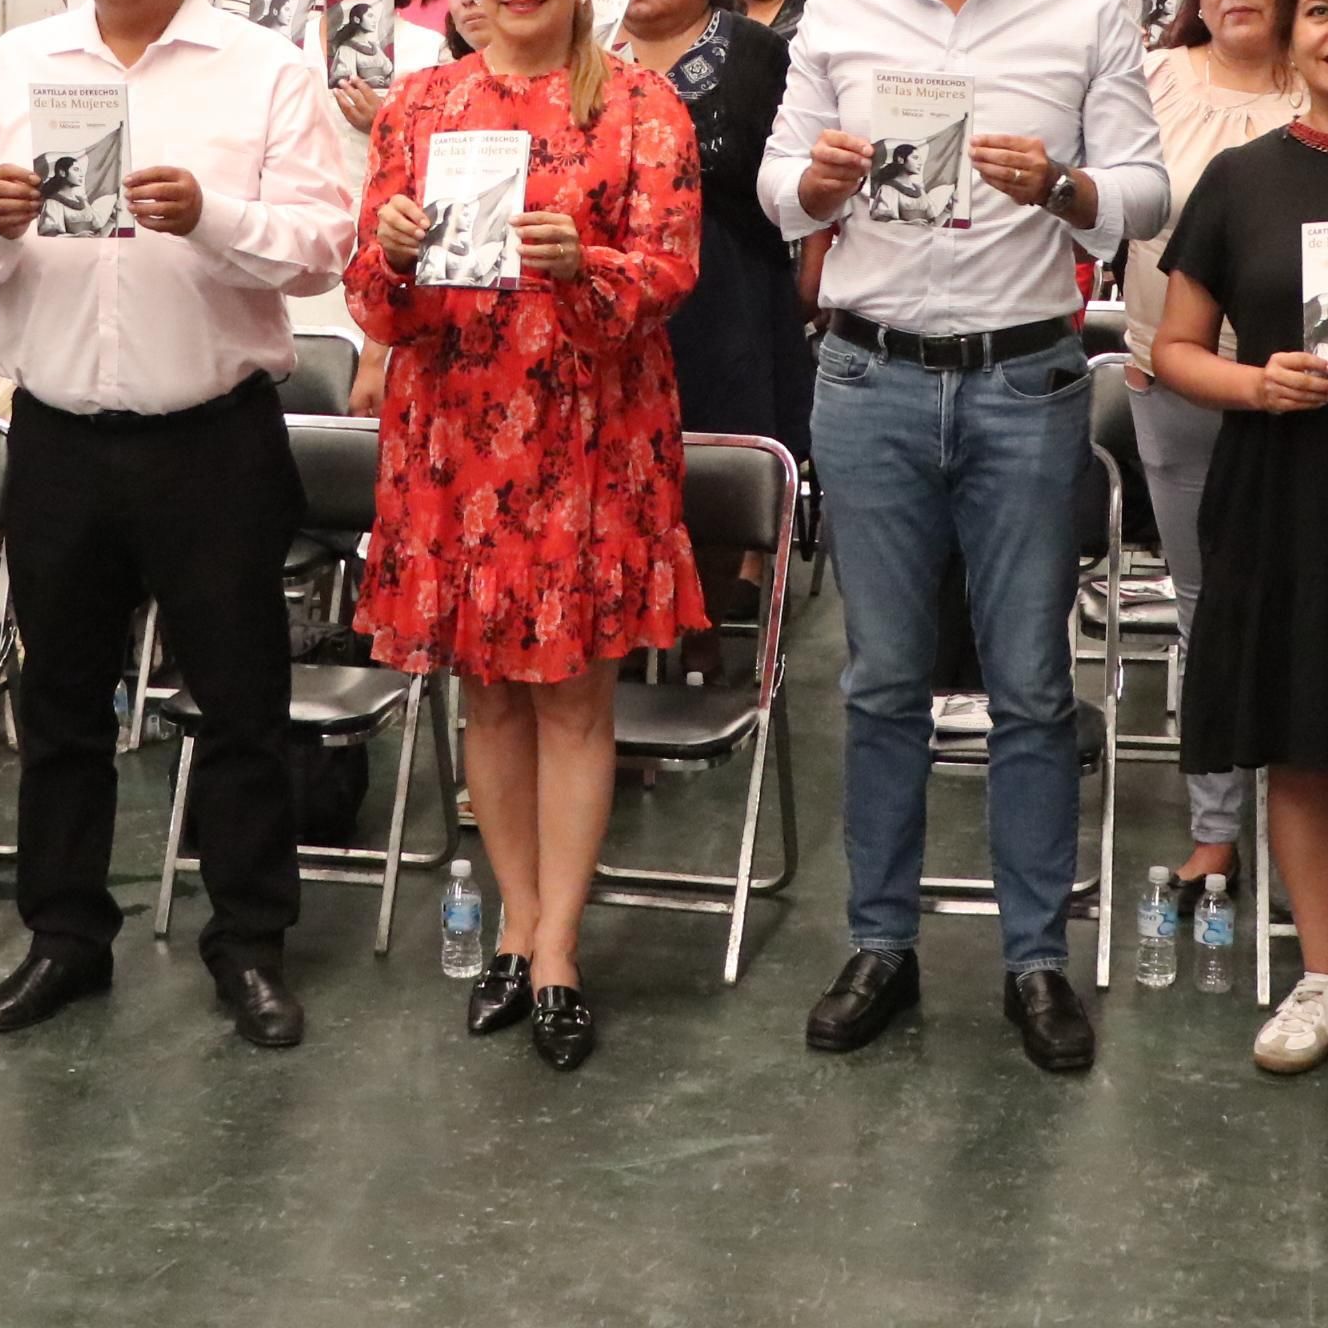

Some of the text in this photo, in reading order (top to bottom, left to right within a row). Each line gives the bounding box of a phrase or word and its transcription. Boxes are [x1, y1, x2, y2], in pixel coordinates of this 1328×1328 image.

[877, 74, 967, 87] CARTILLA DE DERECHOS
[876, 83, 967, 101] de las Mujeres
[34, 98, 119, 111] de las Mujeres
[473, 146, 519, 158] ujeres
[1308, 238, 1323, 248] de
